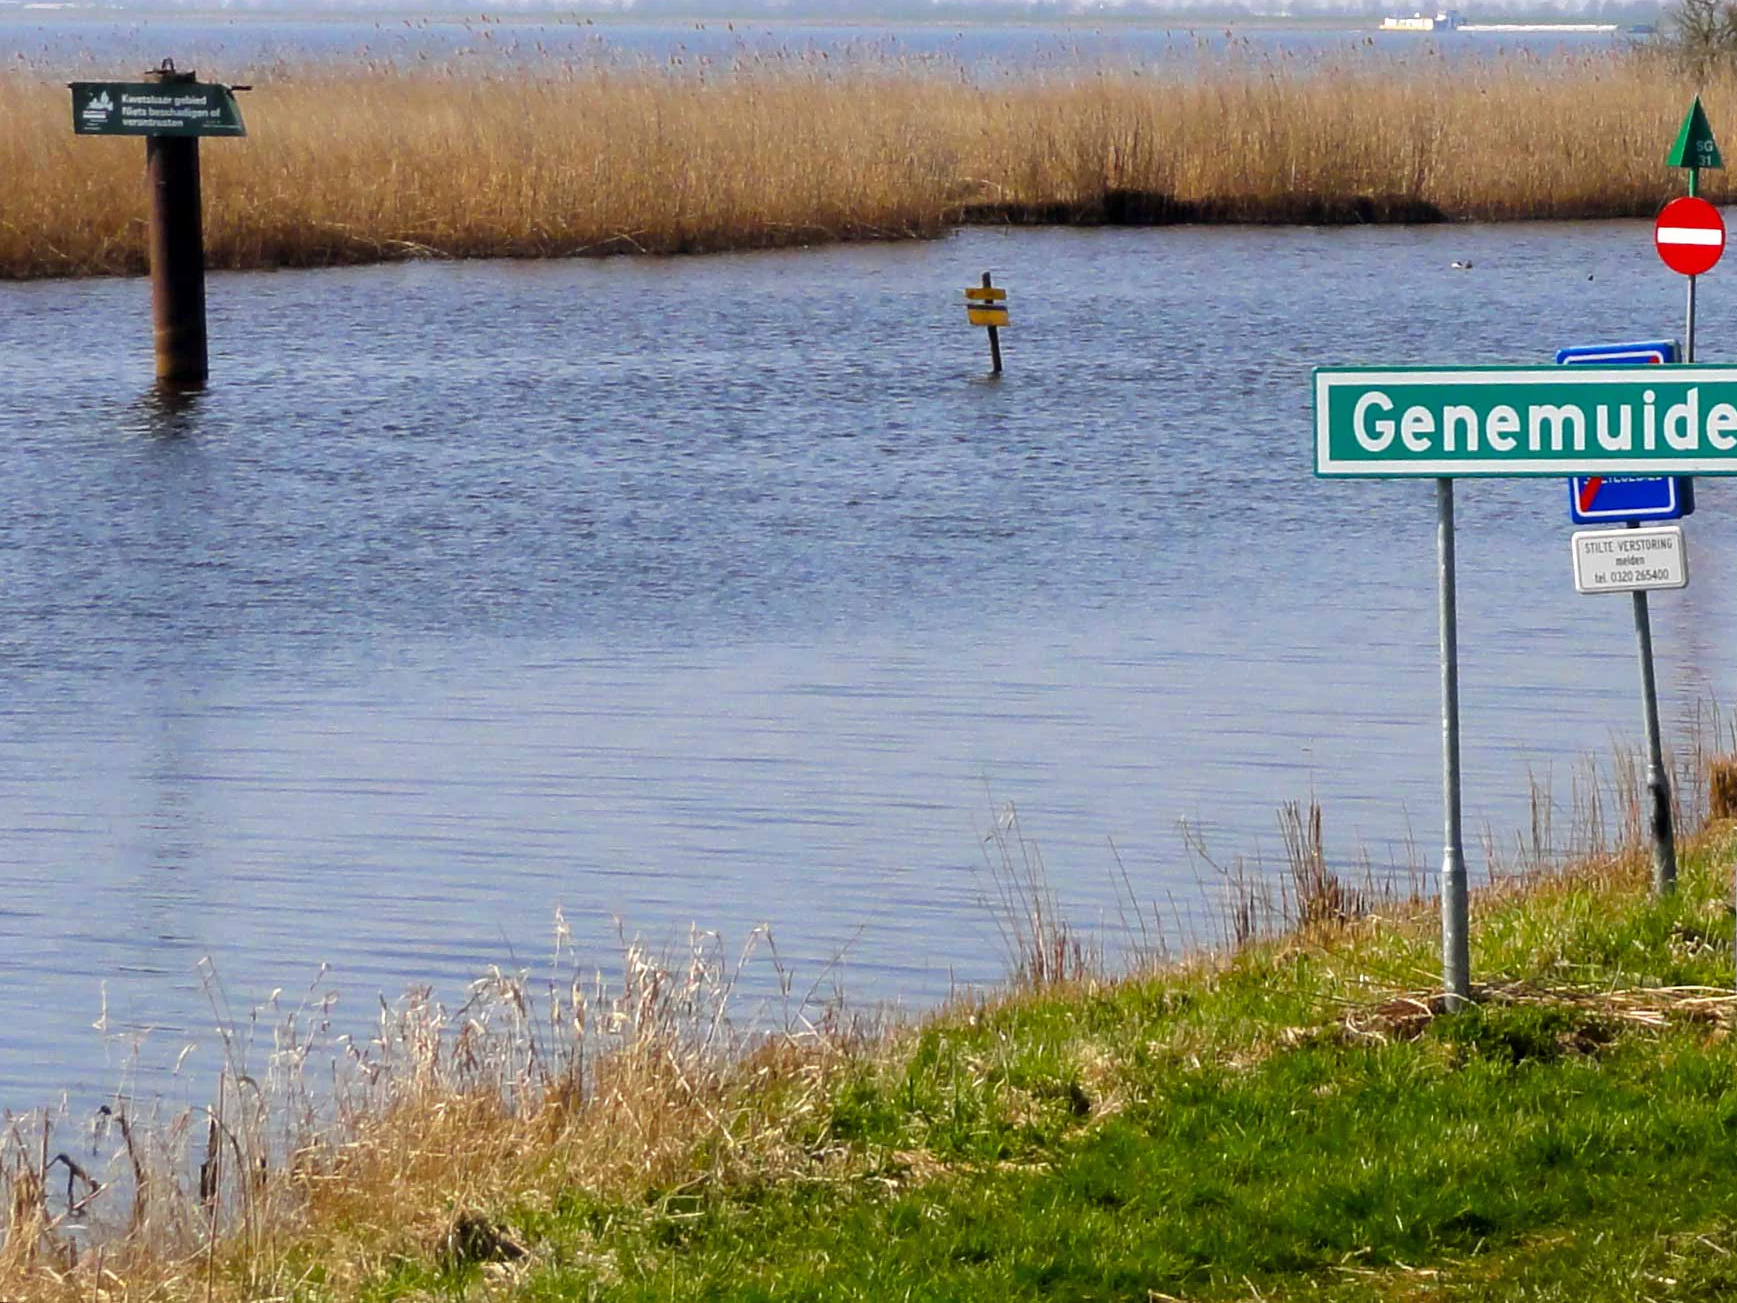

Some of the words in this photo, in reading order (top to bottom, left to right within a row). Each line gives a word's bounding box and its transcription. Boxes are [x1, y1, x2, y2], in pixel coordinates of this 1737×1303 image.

[174, 95, 207, 106] gebied
[121, 106, 147, 116] Niets
[148, 106, 209, 118] beschadigen
[210, 107, 221, 117] of
[1696, 140, 1713, 152] SG
[1585, 541, 1614, 554] STILTE
[1617, 538, 1673, 552] VERSTORING
[1615, 555, 1645, 566] melden
